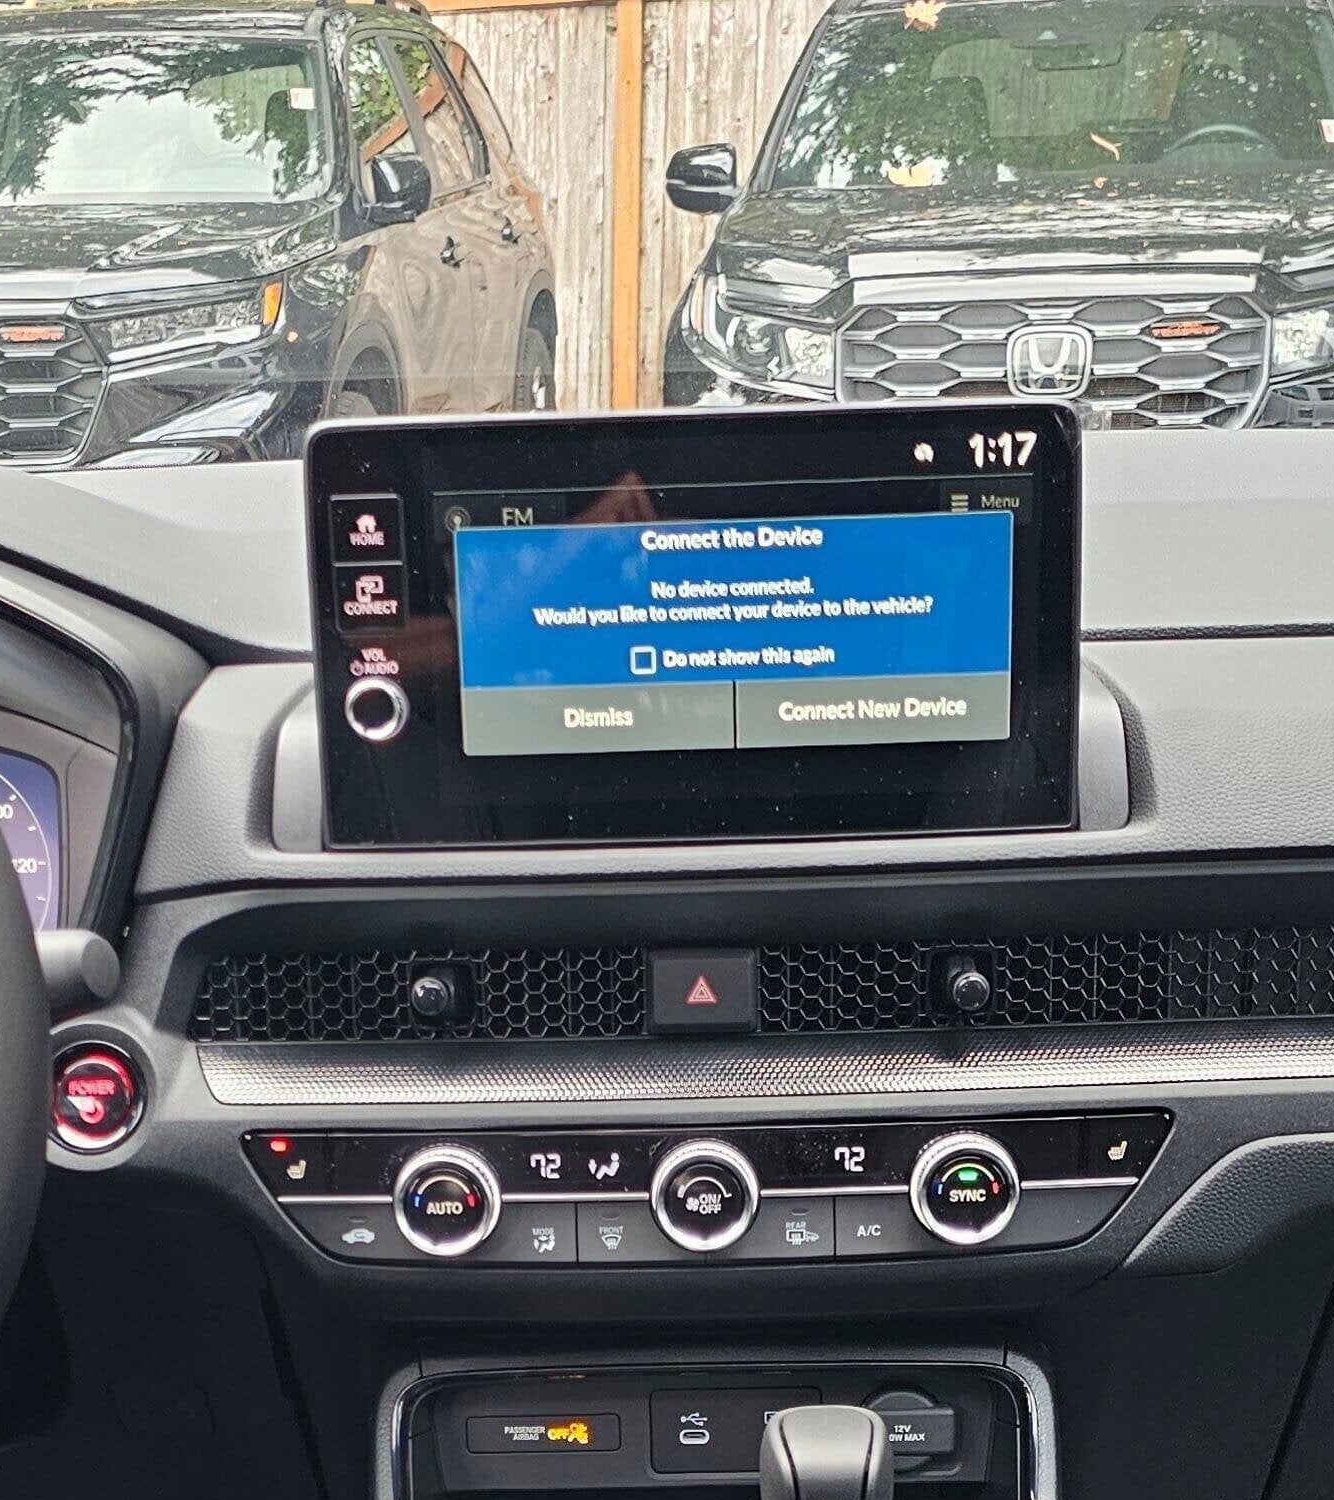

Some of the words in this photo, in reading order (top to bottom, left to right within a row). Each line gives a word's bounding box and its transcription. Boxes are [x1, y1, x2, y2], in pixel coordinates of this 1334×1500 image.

[968, 430, 1037, 468] 1:17
[981, 494, 1020, 509] Menu
[501, 508, 534, 526] FM
[349, 531, 385, 546] HOME
[640, 530, 720, 551] Connect
[722, 527, 755, 549] the
[757, 525, 824, 547] Device
[650, 580, 677, 599] No
[678, 579, 728, 597] device
[730, 576, 815, 596] connected.
[343, 600, 398, 616] CONNECT
[533, 606, 586, 626] Would
[587, 607, 618, 627] you
[619, 605, 648, 623] like
[649, 605, 667, 622] to
[668, 603, 732, 621] connect
[733, 603, 769, 622] your
[771, 599, 822, 618] device
[823, 600, 842, 617] to
[843, 597, 870, 616] the
[871, 595, 934, 615] vehicle?
[360, 648, 386, 662] VOL
[662, 649, 688, 668] Do
[689, 648, 717, 667] not
[717, 648, 761, 666] show
[762, 646, 791, 664] this
[792, 645, 835, 666] again
[364, 661, 400, 676] AUDIO
[778, 699, 855, 721] Connect
[858, 698, 901, 719] New
[905, 696, 968, 718] Device
[563, 707, 634, 728] Dismiss
[530, 1153, 562, 1180] 72
[834, 1146, 866, 1173] 72
[699, 1193, 722, 1204] ON/
[948, 1190, 987, 1203] SYNC
[426, 1202, 464, 1216] AUTO
[699, 1203, 722, 1215] OFF
[532, 1227, 555, 1236] MODE
[599, 1225, 624, 1235] FRONT
[785, 1222, 807, 1230] REAR
[857, 1224, 882, 1238] A/C
[504, 1426, 546, 1434] PASSENGER
[893, 1424, 912, 1433] 12V
[904, 1432, 926, 1442] MAX
